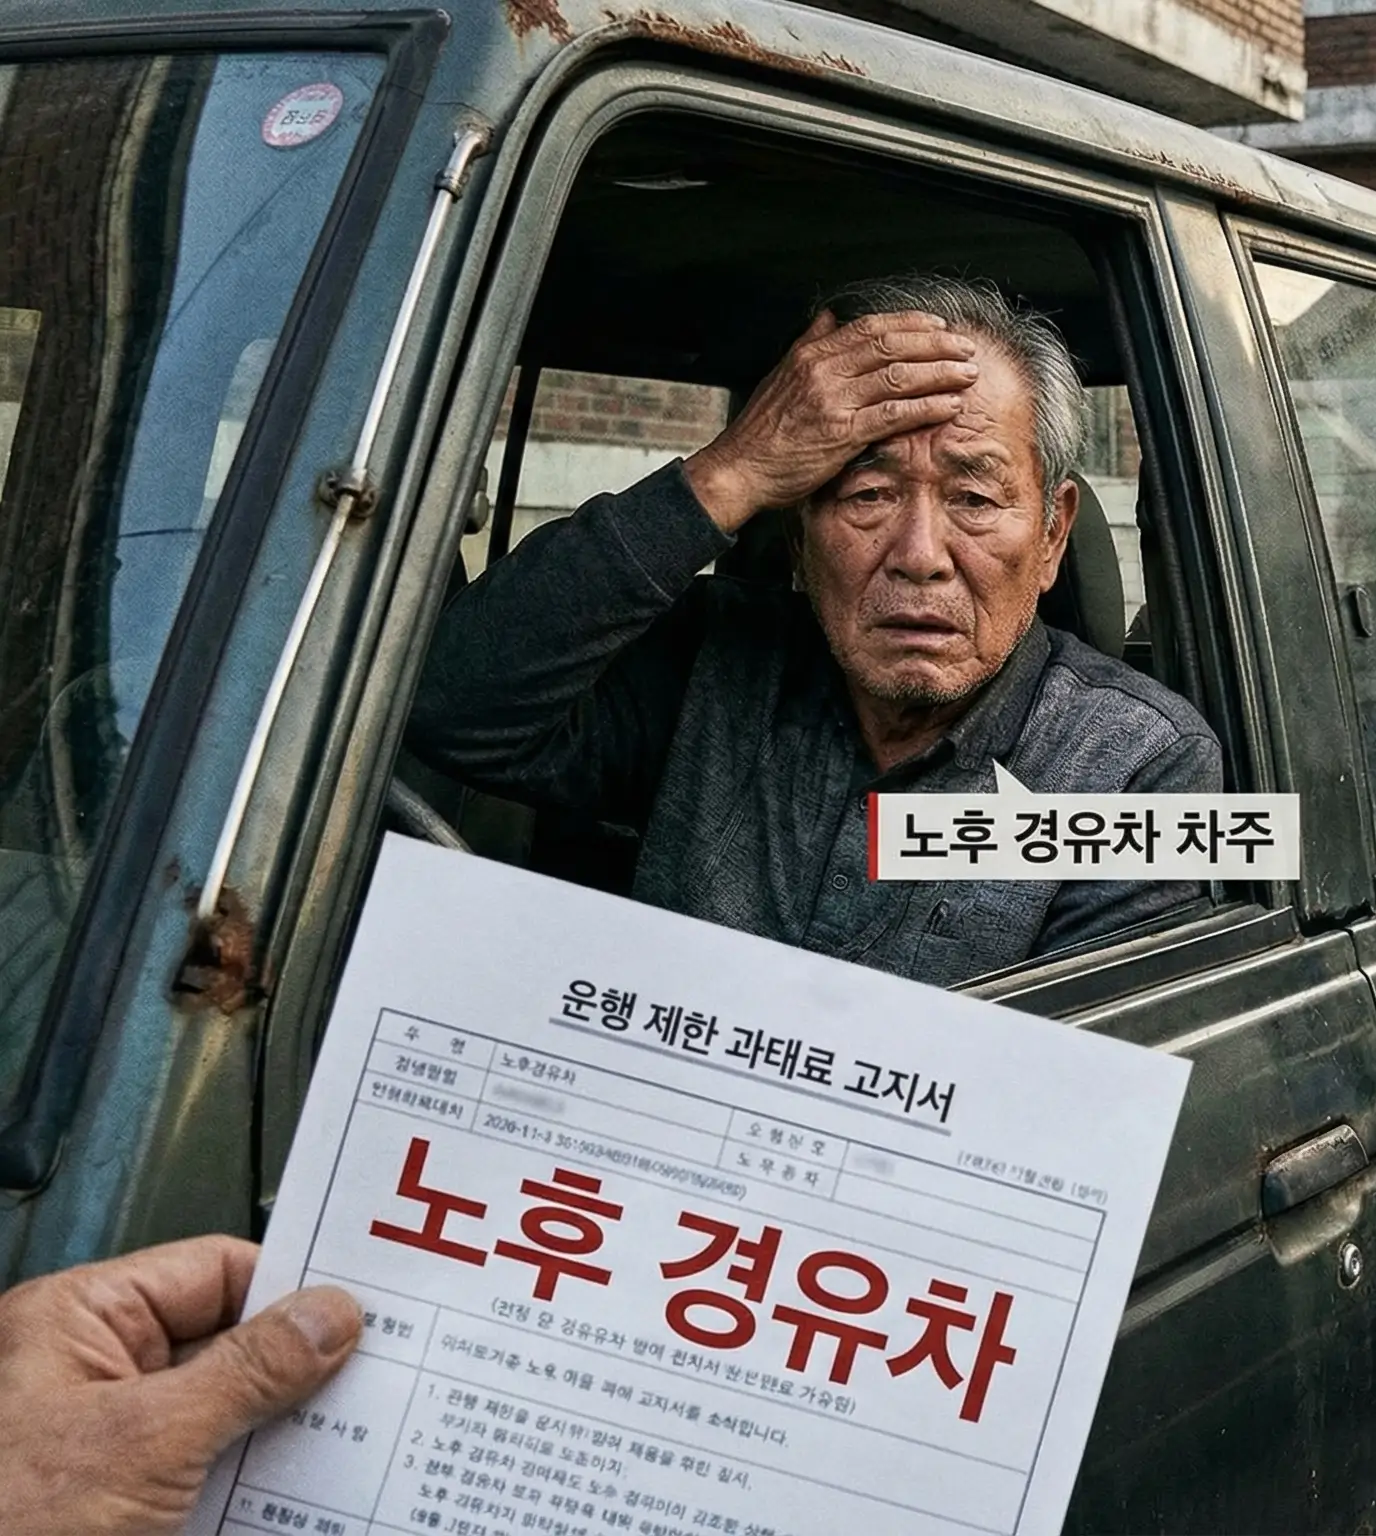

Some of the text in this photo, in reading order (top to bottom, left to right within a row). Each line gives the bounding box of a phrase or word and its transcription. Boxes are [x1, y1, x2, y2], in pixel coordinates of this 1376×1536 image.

[563, 980, 955, 1123] 운행 제한 과태료 고지서
[369, 1137, 1016, 1424] 노후 경유차
